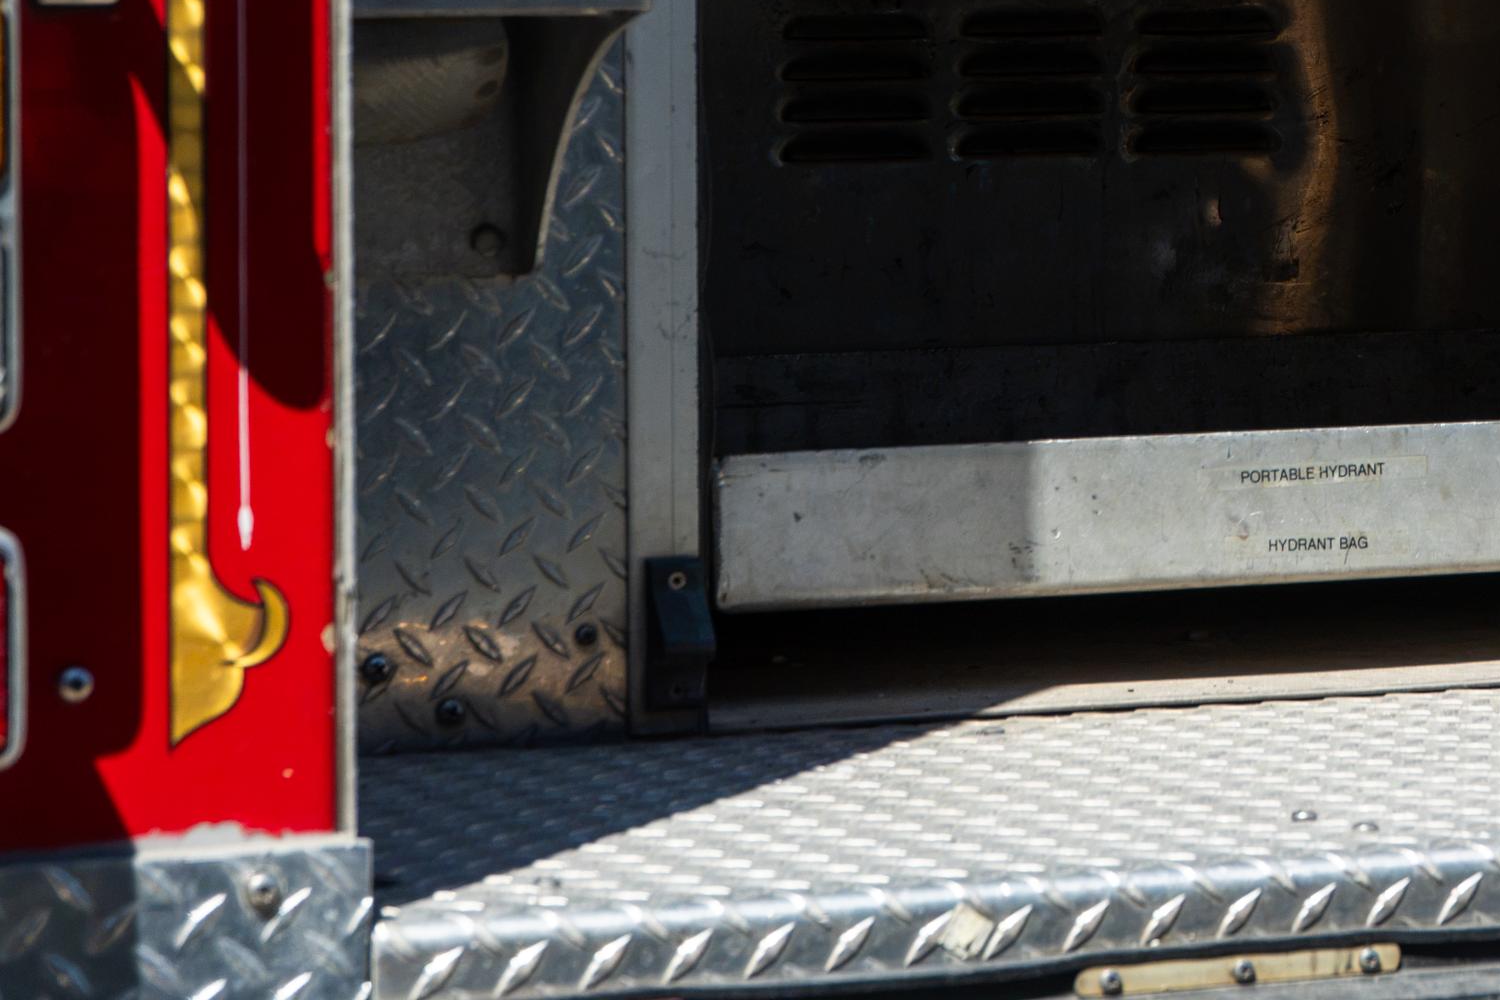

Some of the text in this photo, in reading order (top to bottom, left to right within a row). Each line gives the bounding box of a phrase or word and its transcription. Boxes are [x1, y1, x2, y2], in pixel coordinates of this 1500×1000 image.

[1240, 462, 1386, 484] PORTABLE HYDRANT
[1268, 536, 1368, 552] HYDRANT BAG
